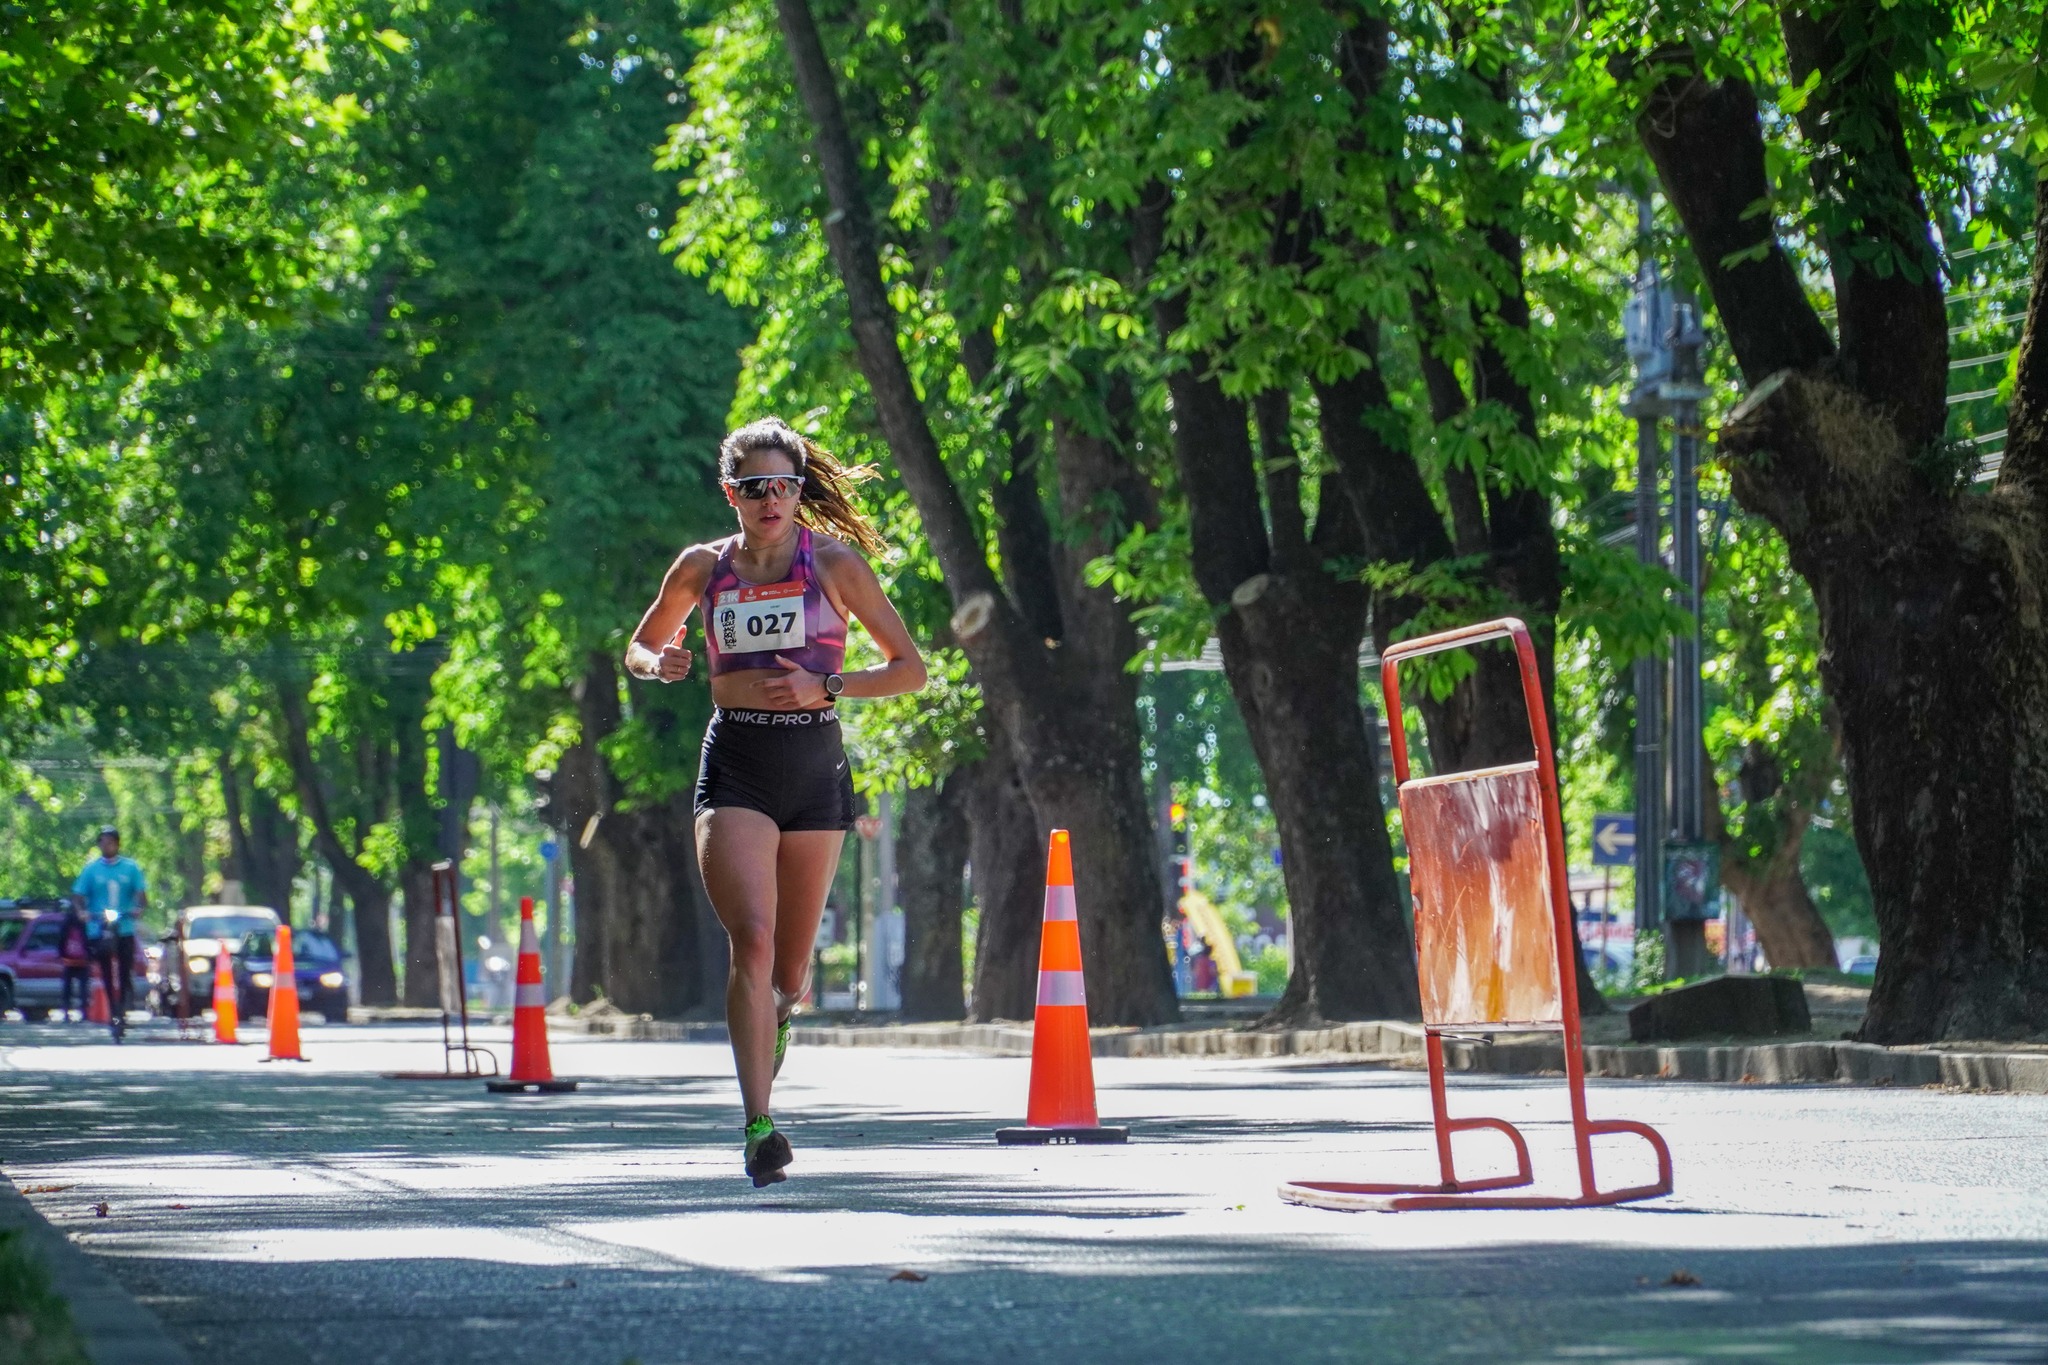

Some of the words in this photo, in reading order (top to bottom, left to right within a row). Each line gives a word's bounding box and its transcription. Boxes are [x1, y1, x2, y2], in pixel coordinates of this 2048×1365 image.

[719, 592, 739, 604] 21K
[747, 612, 797, 637] 027
[728, 711, 771, 724] NIKE
[771, 713, 812, 726] PRO
